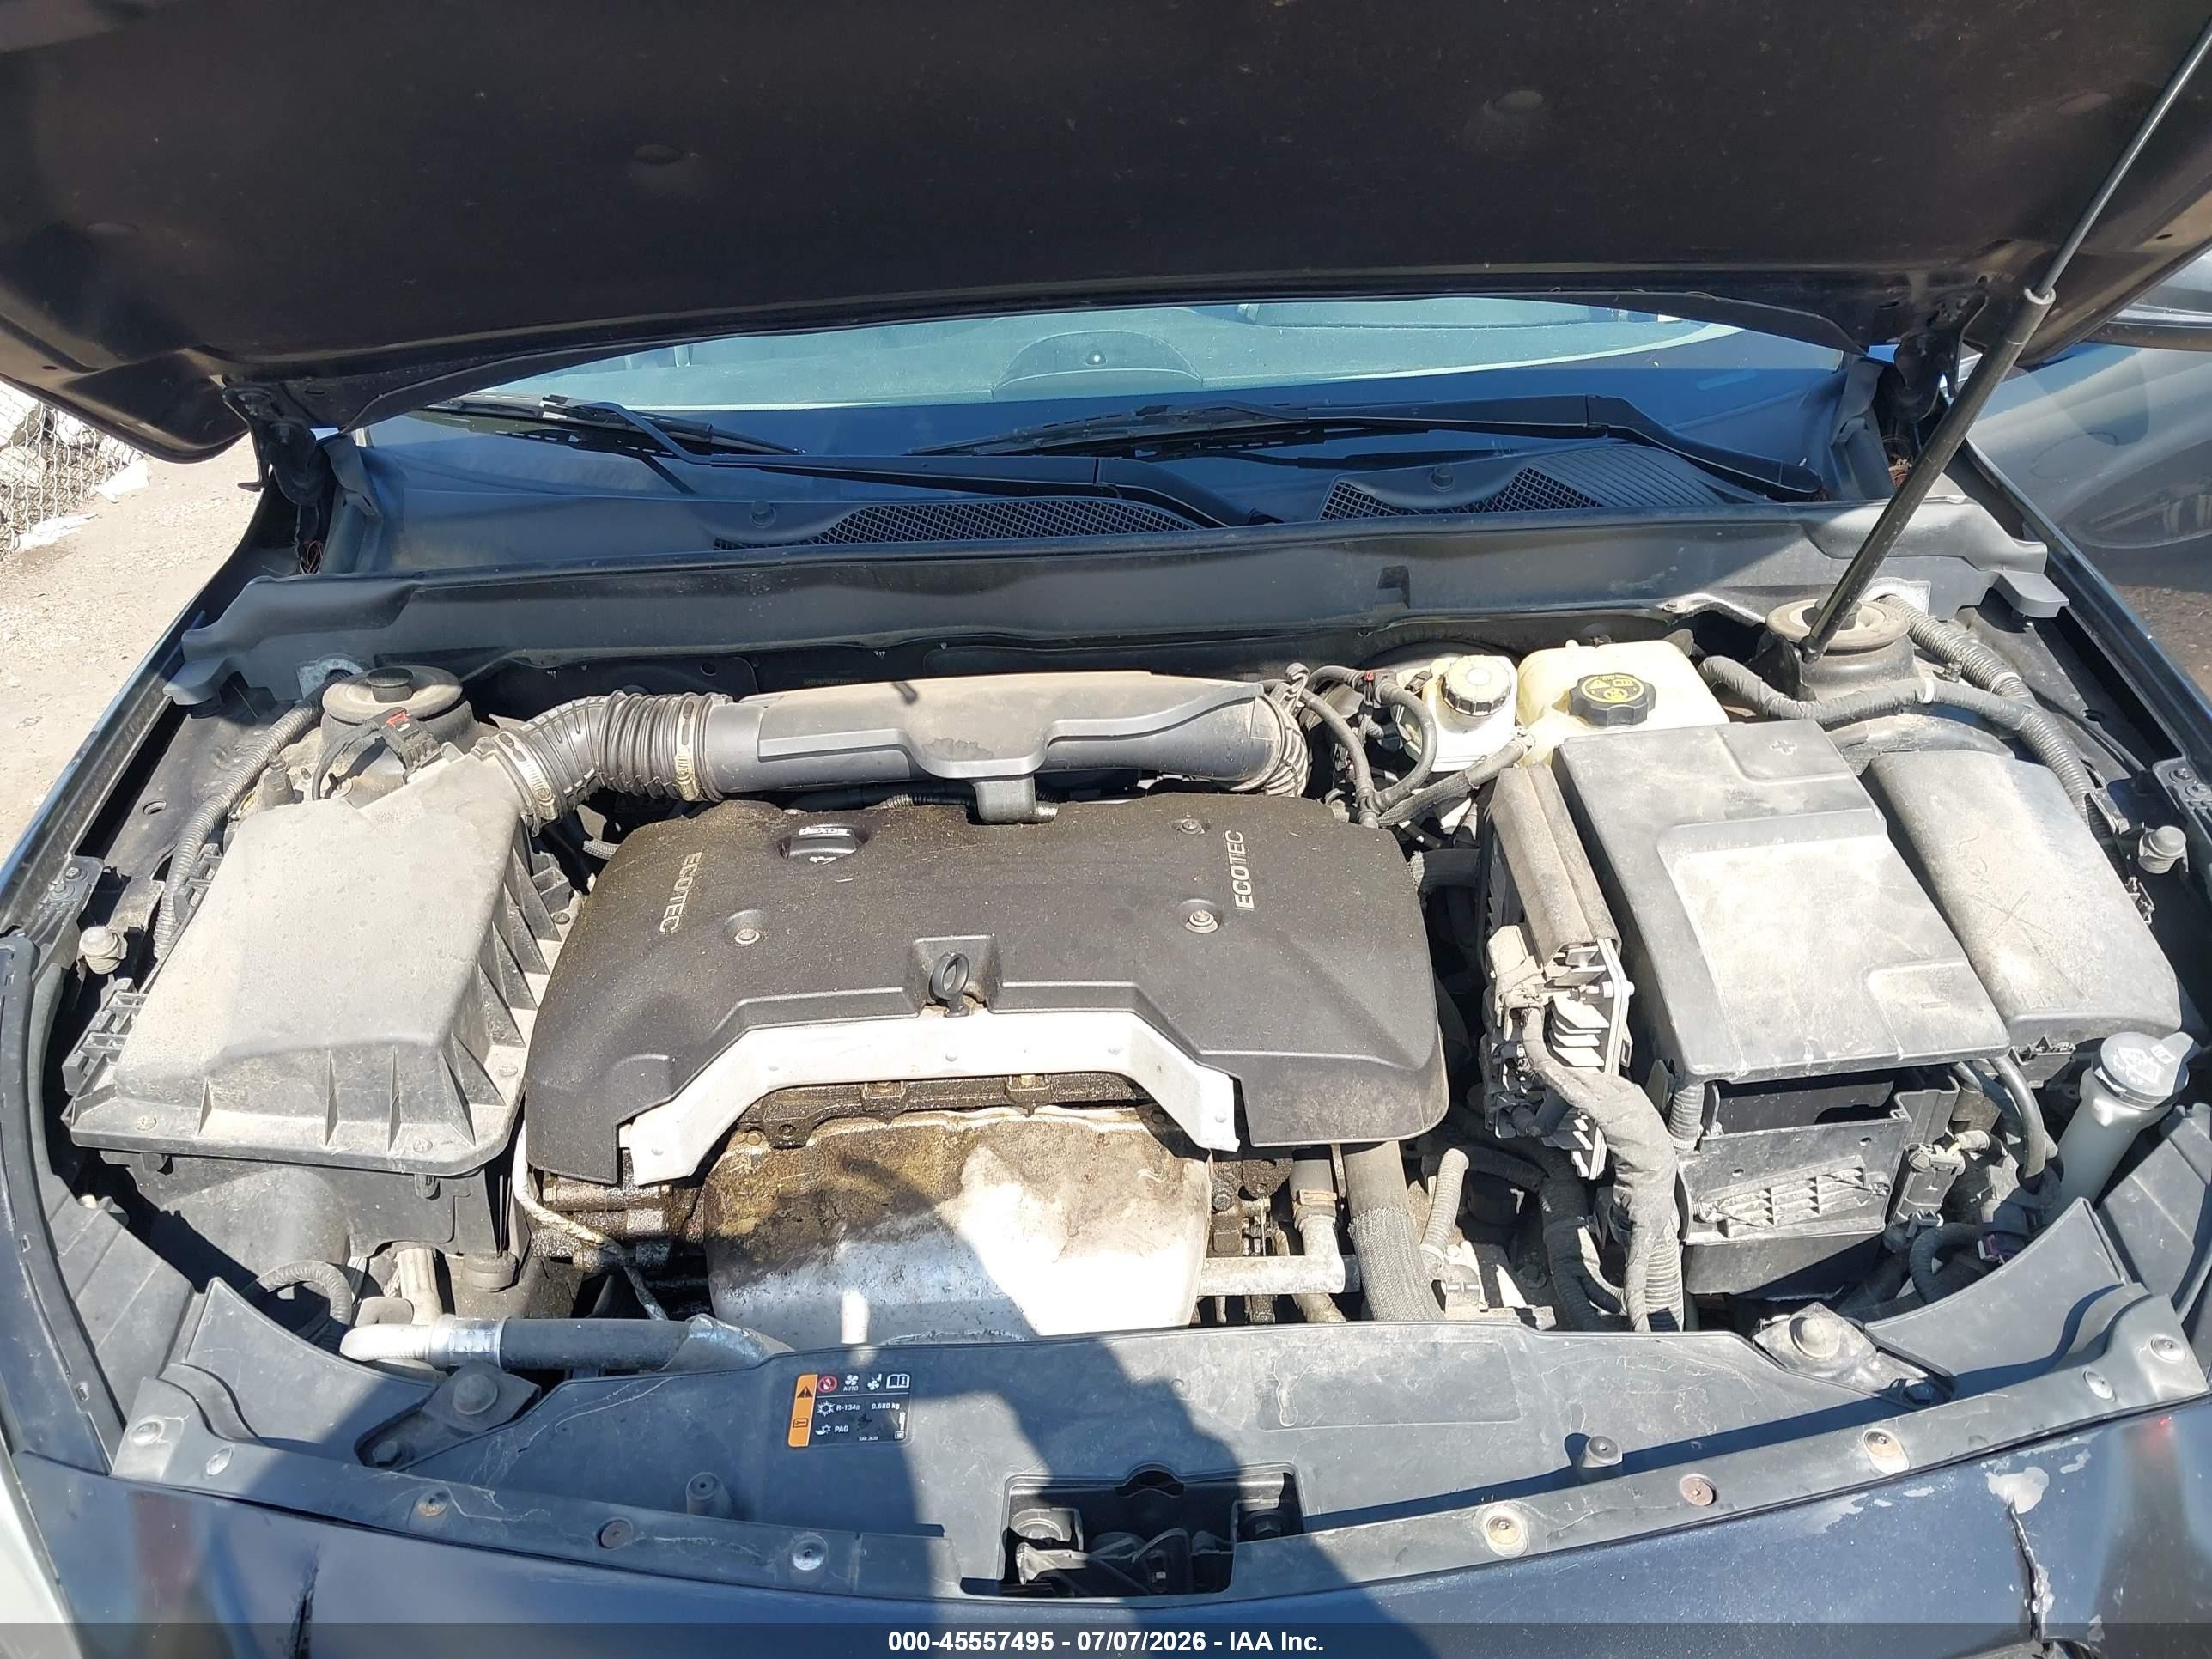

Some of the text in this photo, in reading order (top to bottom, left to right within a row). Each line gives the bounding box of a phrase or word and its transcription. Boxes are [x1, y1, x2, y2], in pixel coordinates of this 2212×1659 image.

[659, 852, 702, 933] ECOTEC
[1224, 830, 1255, 910] ECOTEC
[834, 1425, 849, 1433] PAG
